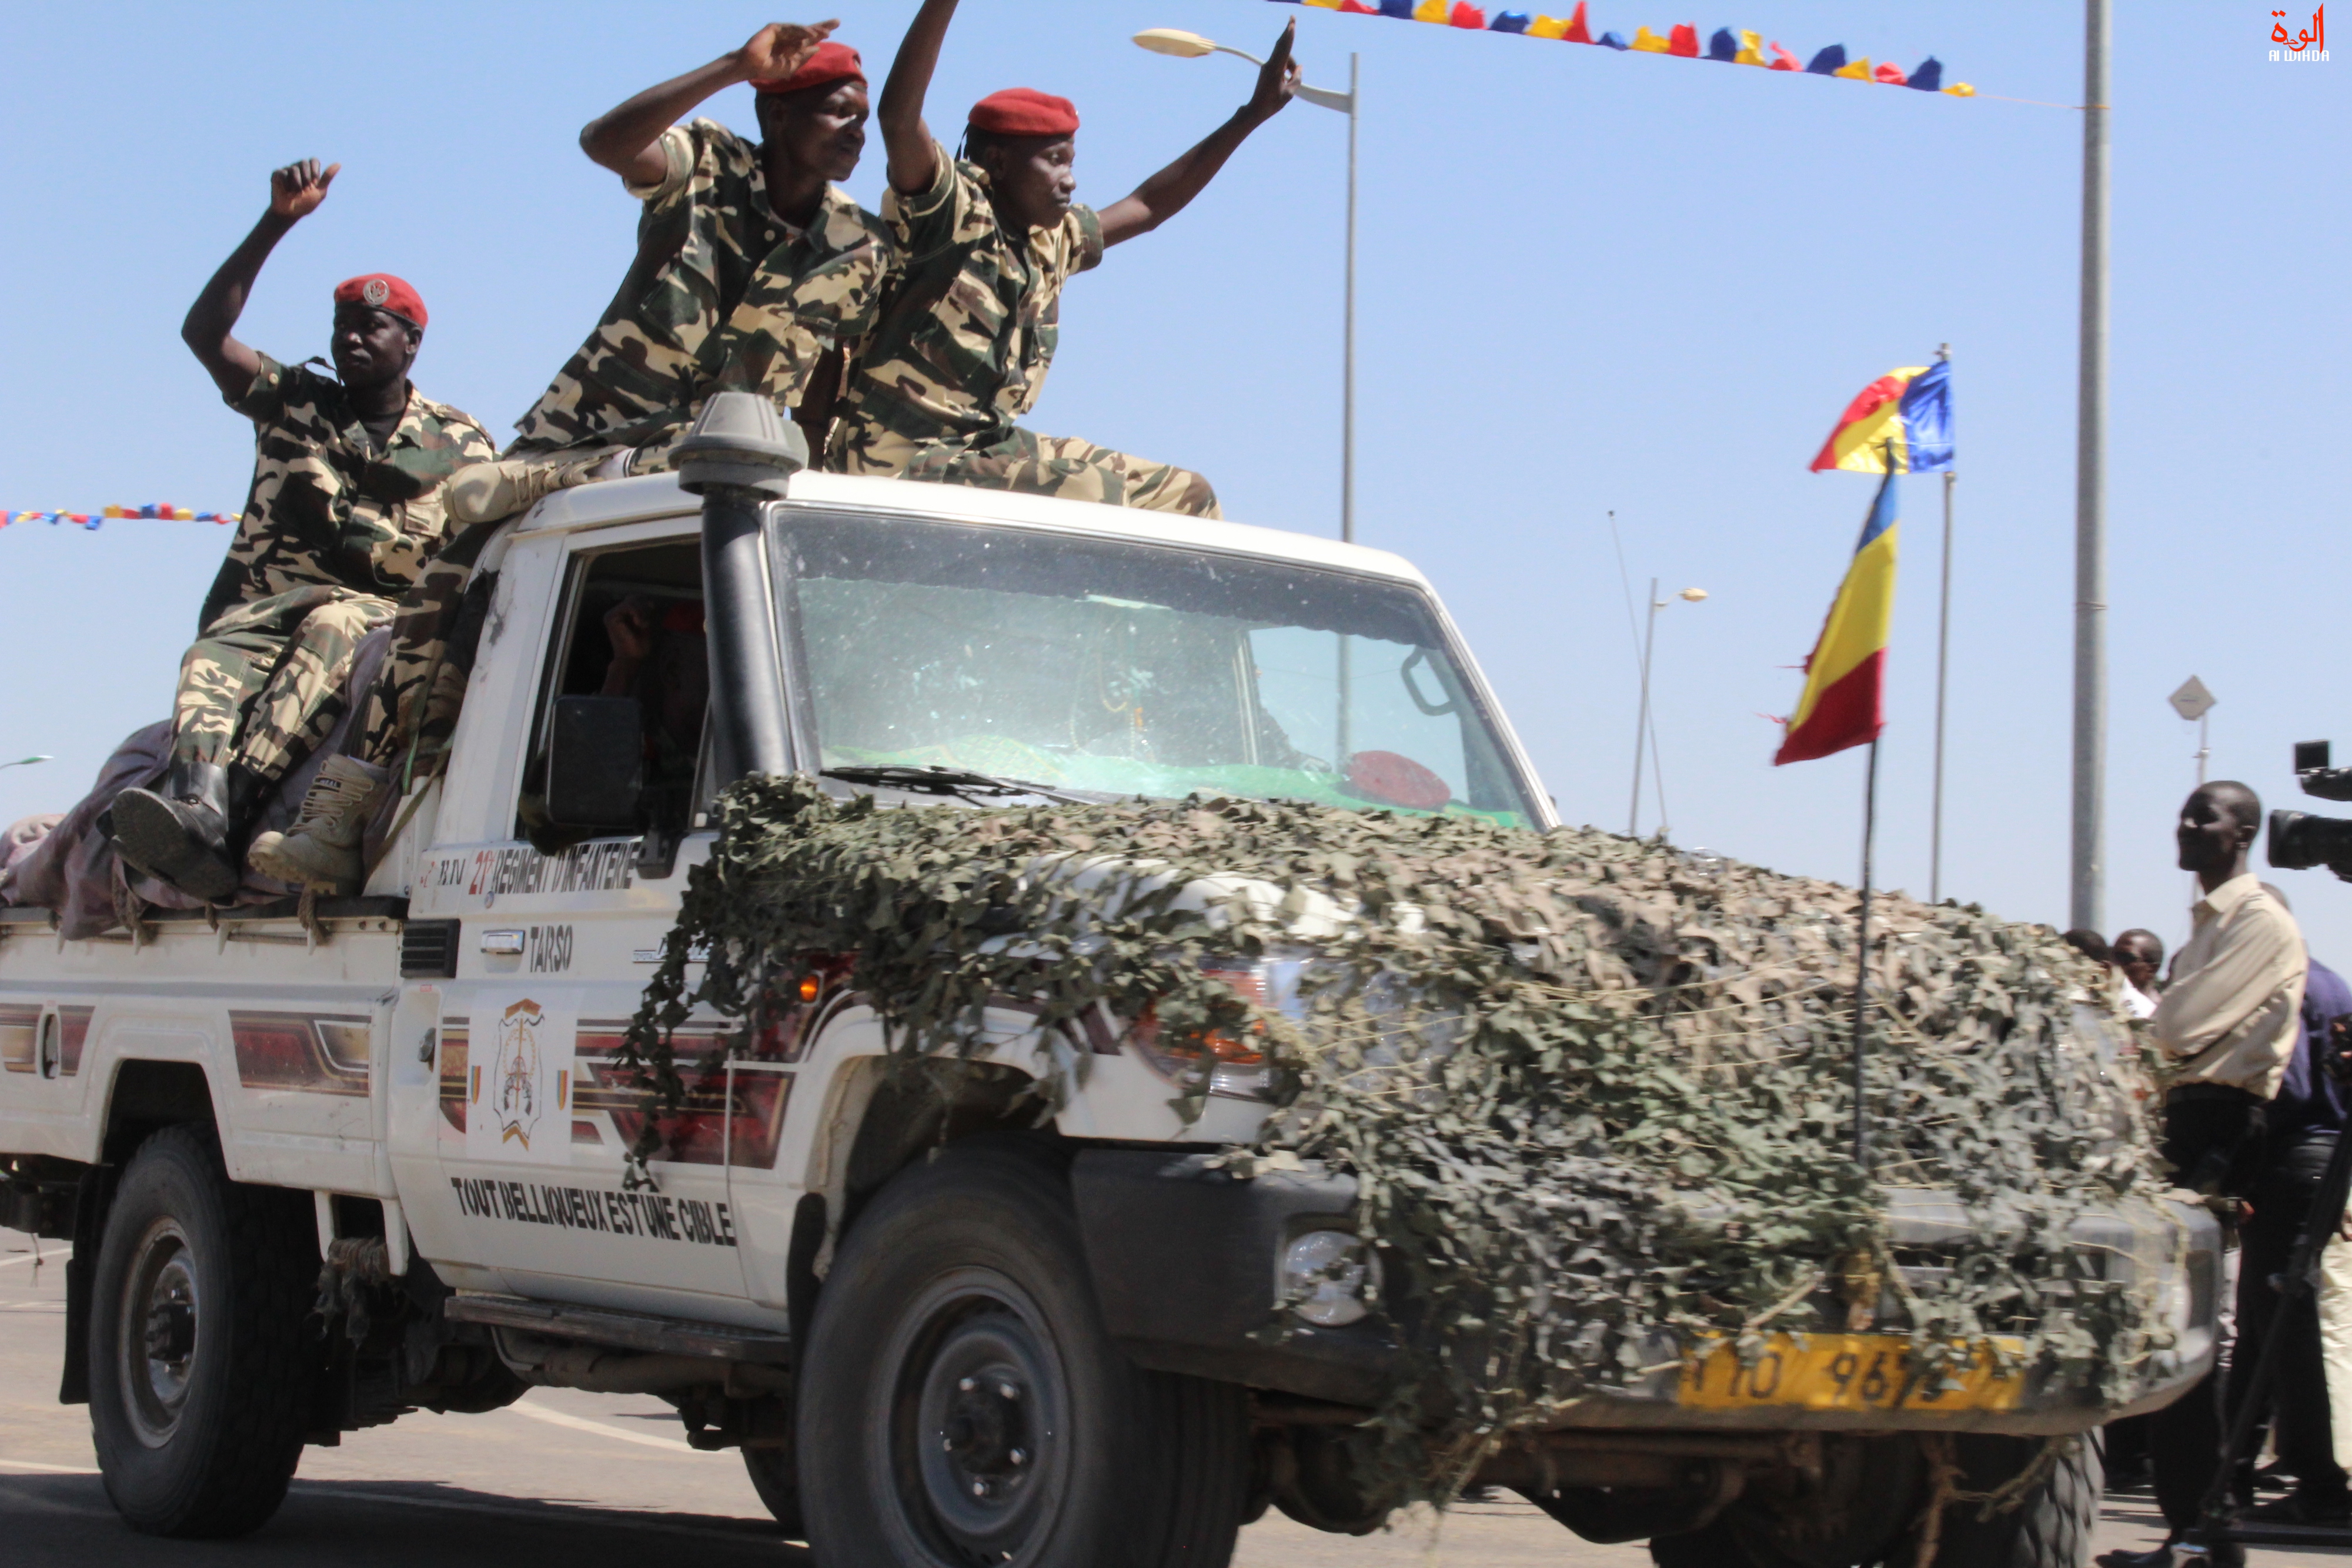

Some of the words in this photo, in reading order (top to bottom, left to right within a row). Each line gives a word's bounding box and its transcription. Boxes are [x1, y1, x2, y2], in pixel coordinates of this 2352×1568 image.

[530, 924, 573, 973] TARSO
[451, 1177, 502, 1219] TOUT
[498, 1181, 609, 1231] BELLIQUEUX
[605, 1192, 644, 1236] EST
[640, 1196, 680, 1241] UNE
[678, 1198, 737, 1247] CIBLE
